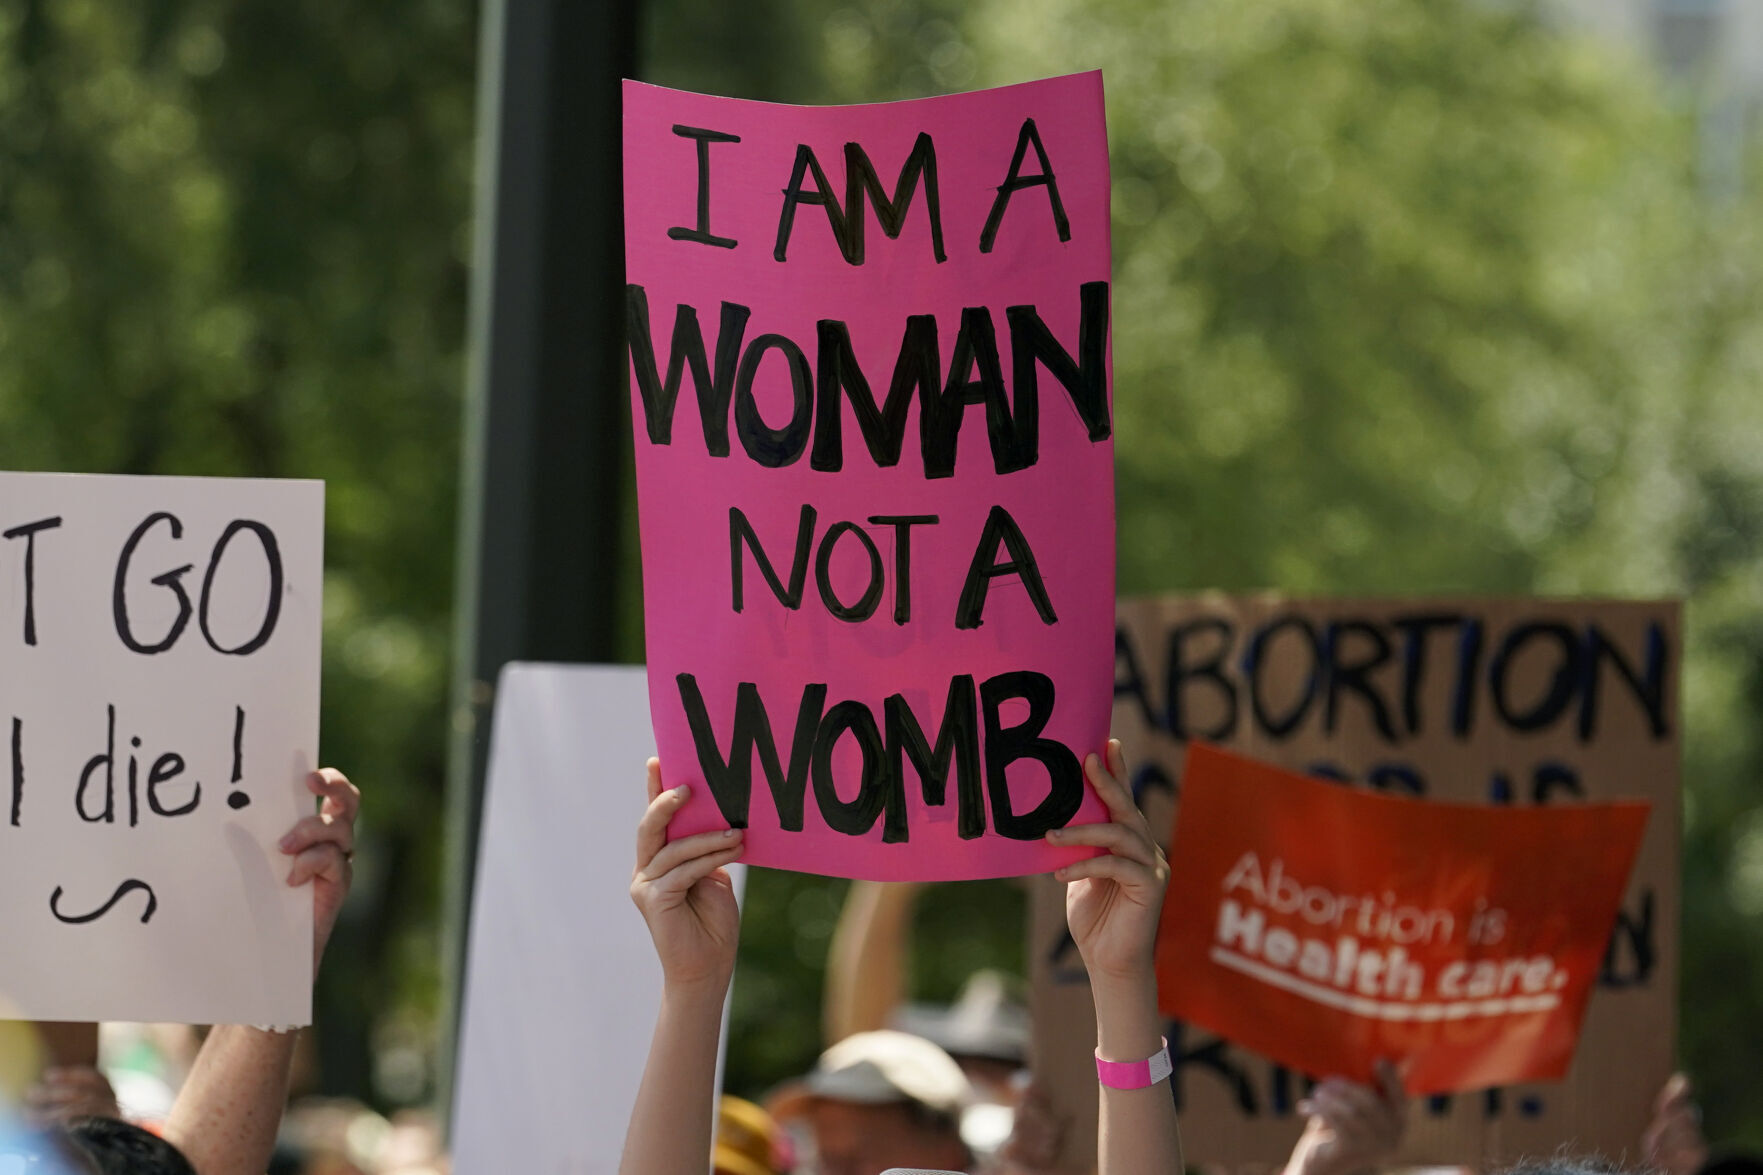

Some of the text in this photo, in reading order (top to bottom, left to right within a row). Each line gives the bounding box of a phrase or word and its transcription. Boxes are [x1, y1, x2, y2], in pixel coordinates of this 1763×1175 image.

[667, 117, 1072, 266] I AM A
[626, 281, 1112, 480] WOMAN
[112, 511, 283, 656] GO
[729, 503, 1059, 630] NOT A
[676, 671, 1085, 843] WOMB
[1215, 897, 1569, 1001] Health care.
[1221, 850, 1455, 945] Abortion
[1468, 894, 1509, 947] is
